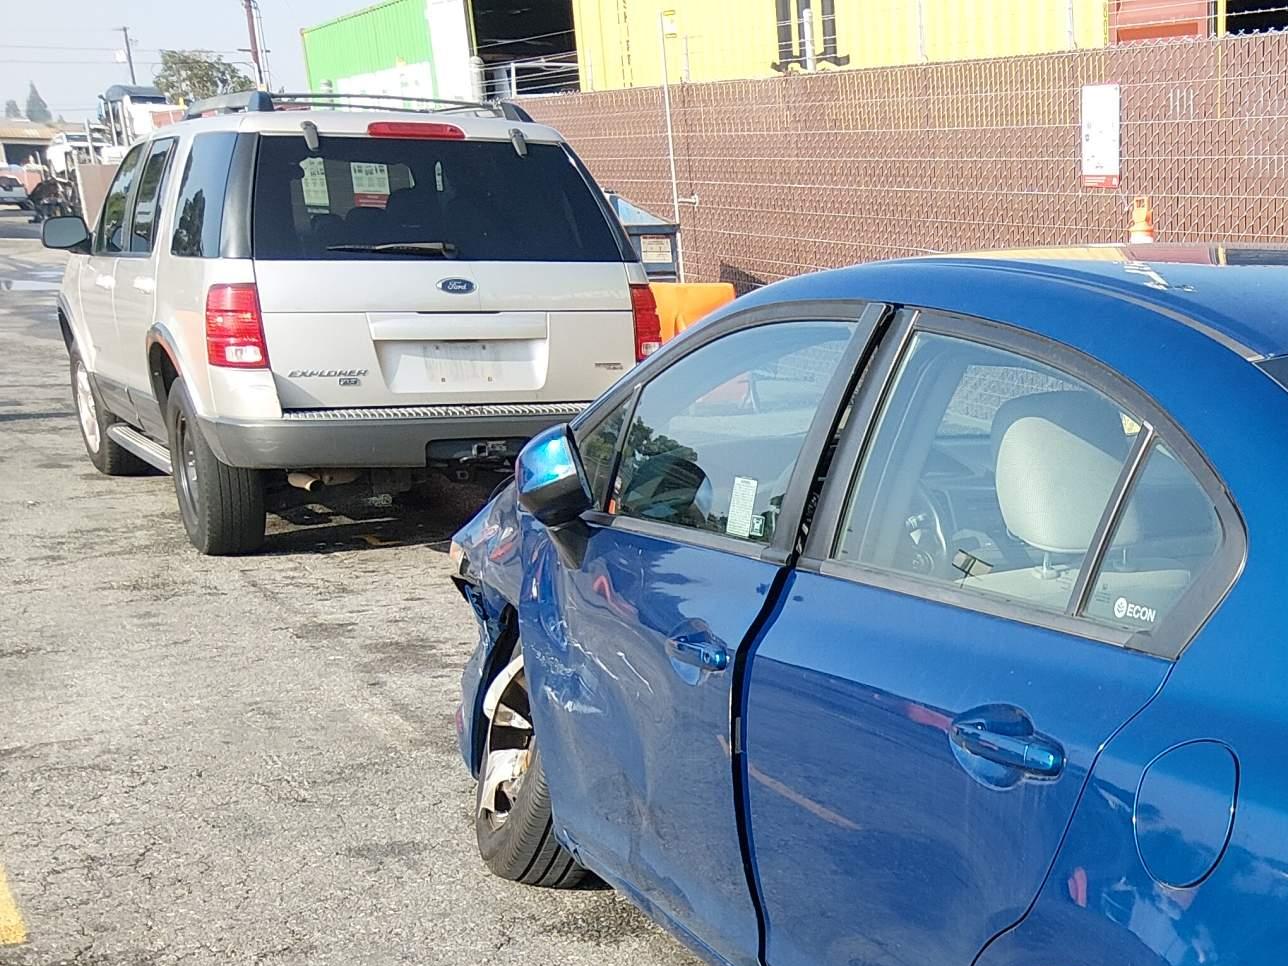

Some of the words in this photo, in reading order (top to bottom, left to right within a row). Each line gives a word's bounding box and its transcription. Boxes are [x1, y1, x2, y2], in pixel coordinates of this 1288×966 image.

[447, 280, 468, 290] Ford
[287, 369, 369, 378] EXPLORER
[1126, 603, 1156, 623] ECON
